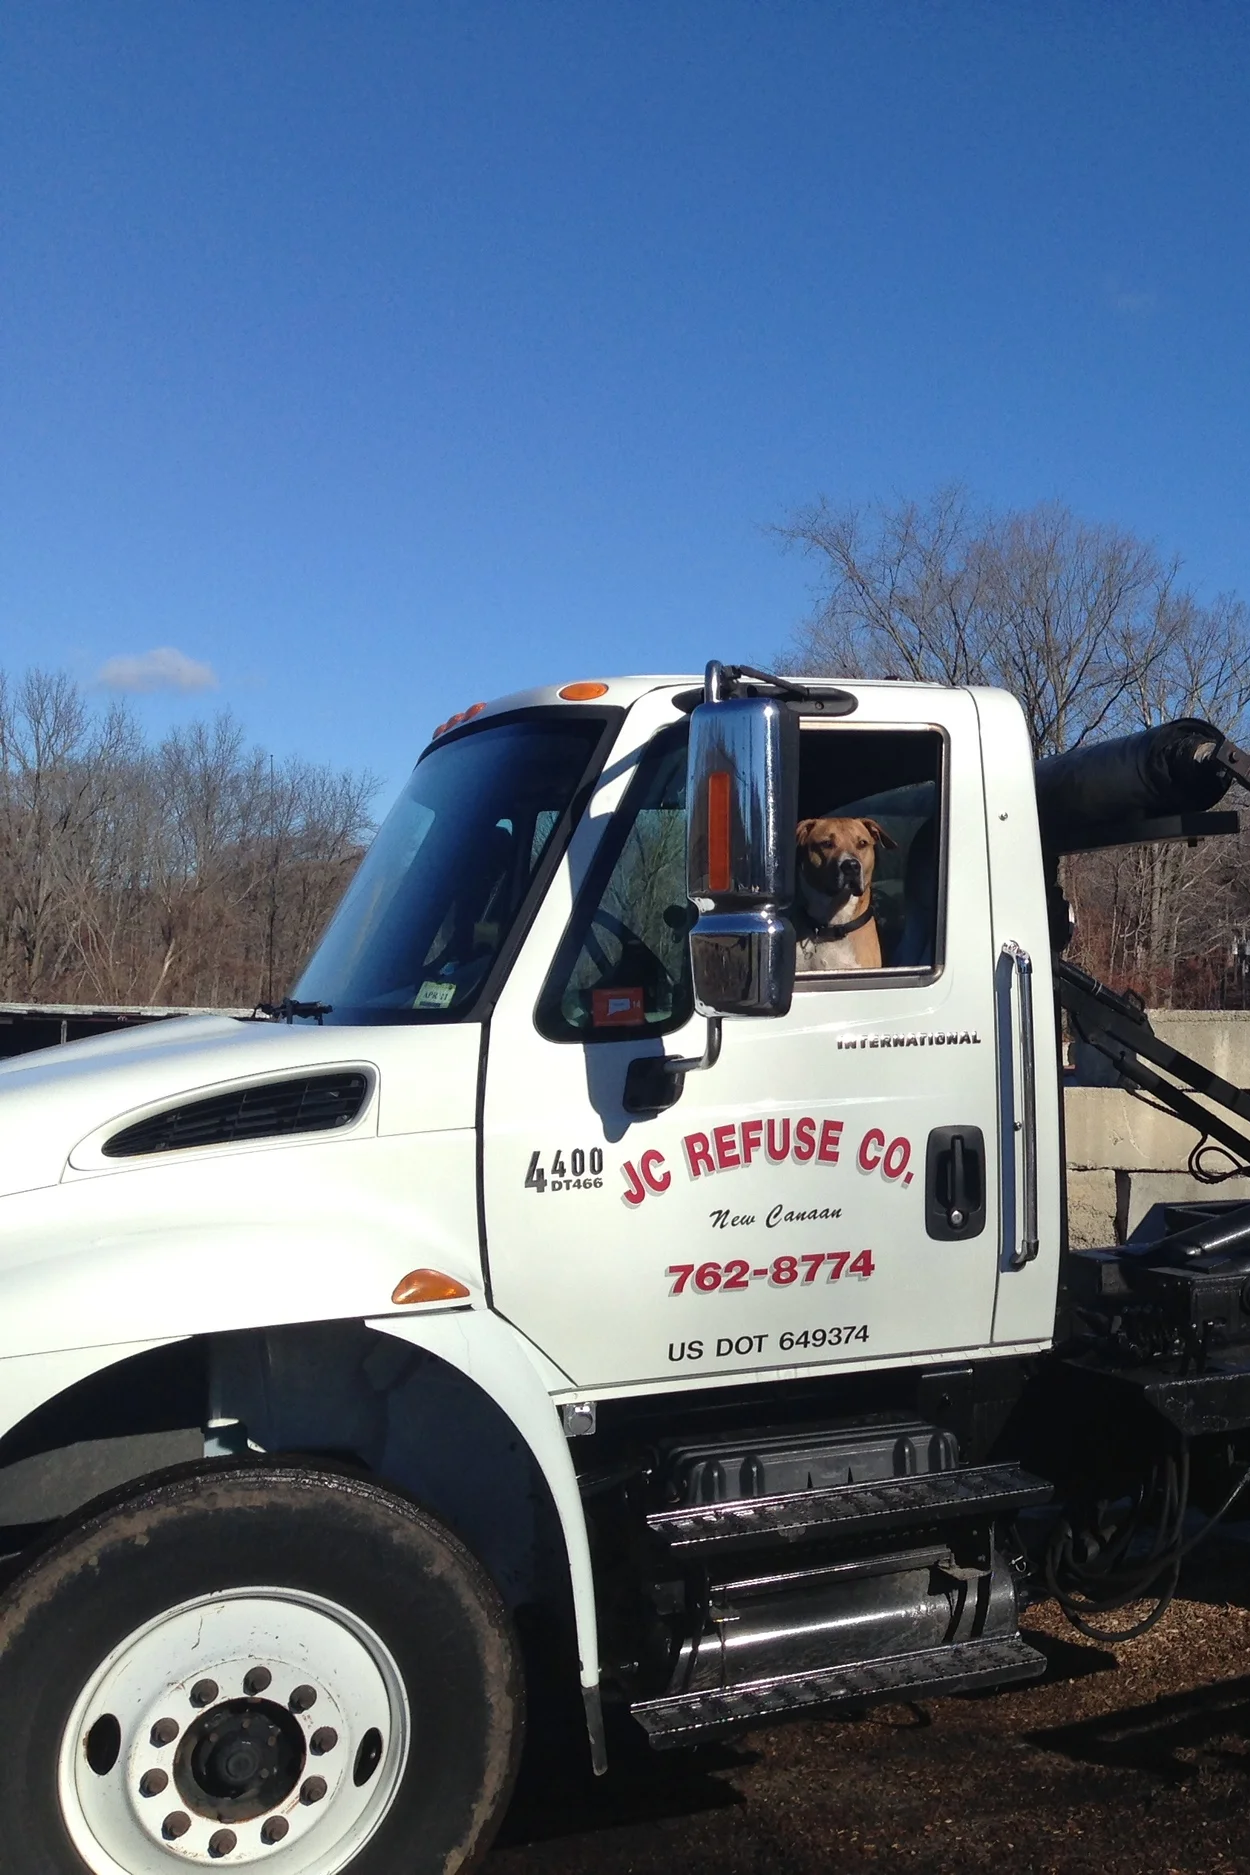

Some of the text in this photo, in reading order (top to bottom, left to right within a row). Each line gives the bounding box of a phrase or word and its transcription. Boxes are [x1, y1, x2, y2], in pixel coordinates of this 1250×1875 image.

[837, 1031, 981, 1050] INTERNATIONAL
[524, 1146, 604, 1194] 4400
[620, 1117, 914, 1210] JC REFUSE CO.
[551, 1177, 604, 1192] DT466
[709, 1204, 843, 1230] New Canaan
[665, 1249, 876, 1298] 762-8774
[668, 1324, 870, 1362] US DOT 649374
